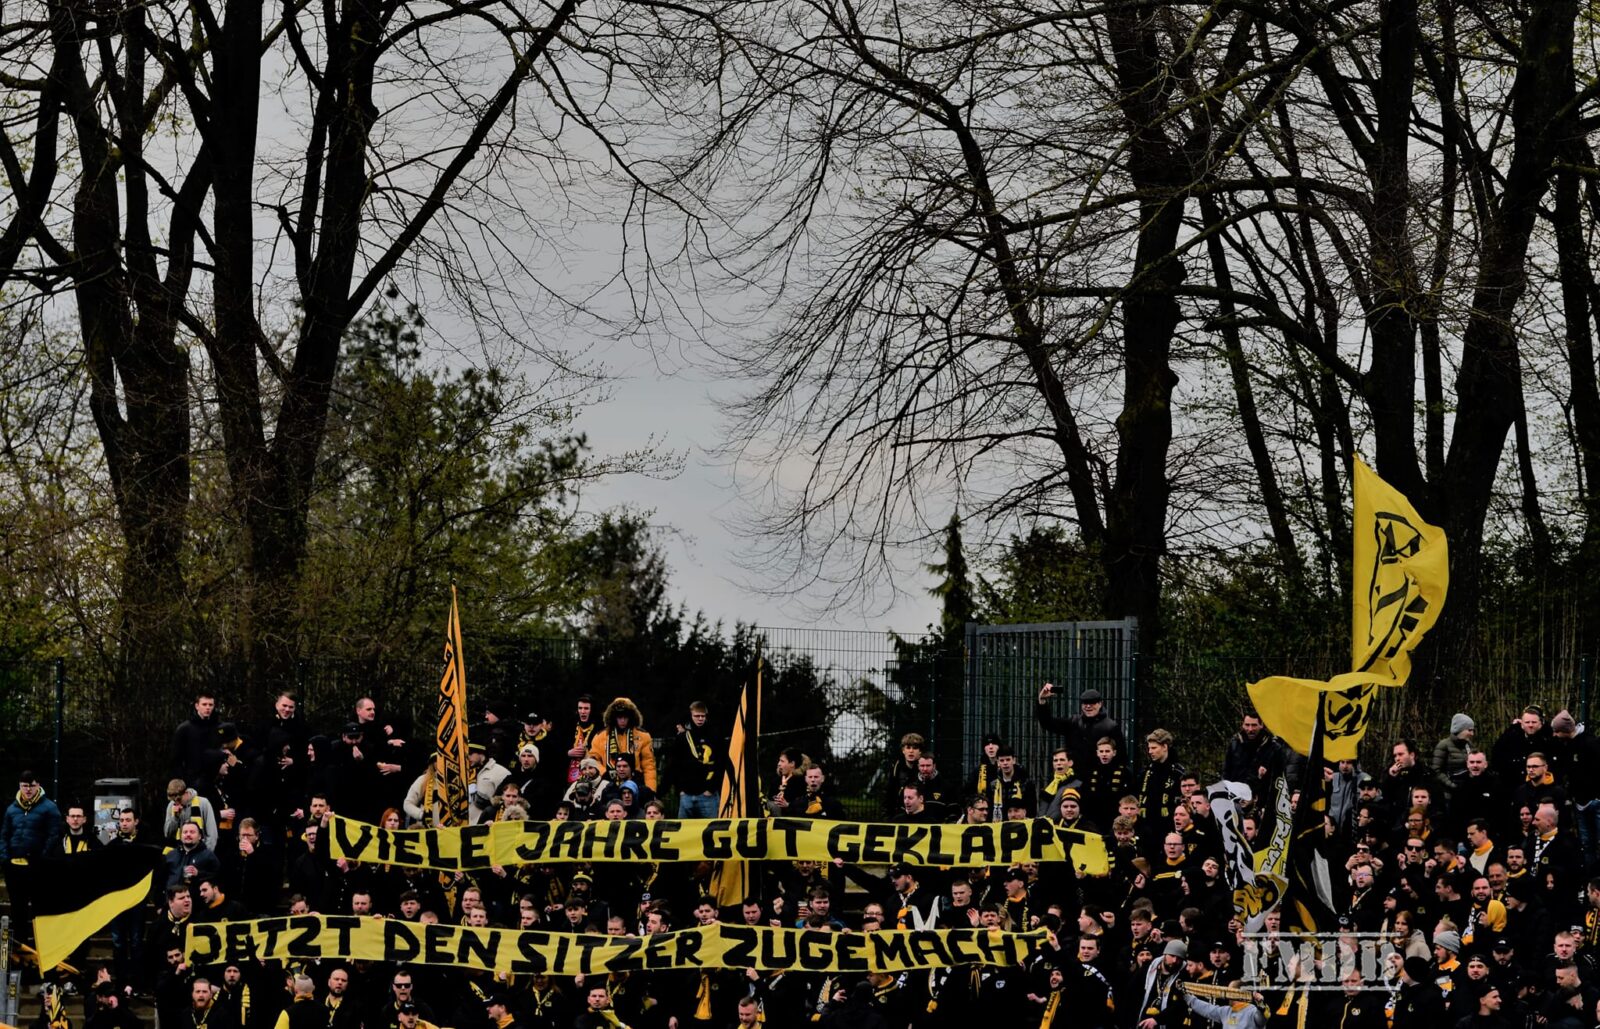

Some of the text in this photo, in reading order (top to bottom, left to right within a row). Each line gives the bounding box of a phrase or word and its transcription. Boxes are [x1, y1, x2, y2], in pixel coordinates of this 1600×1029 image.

[335, 818, 1086, 869] VIELE JAHRE GUT GEKLAPPT
[189, 916, 1049, 973] JETZT DEN SITZER ZUGEMACHT
